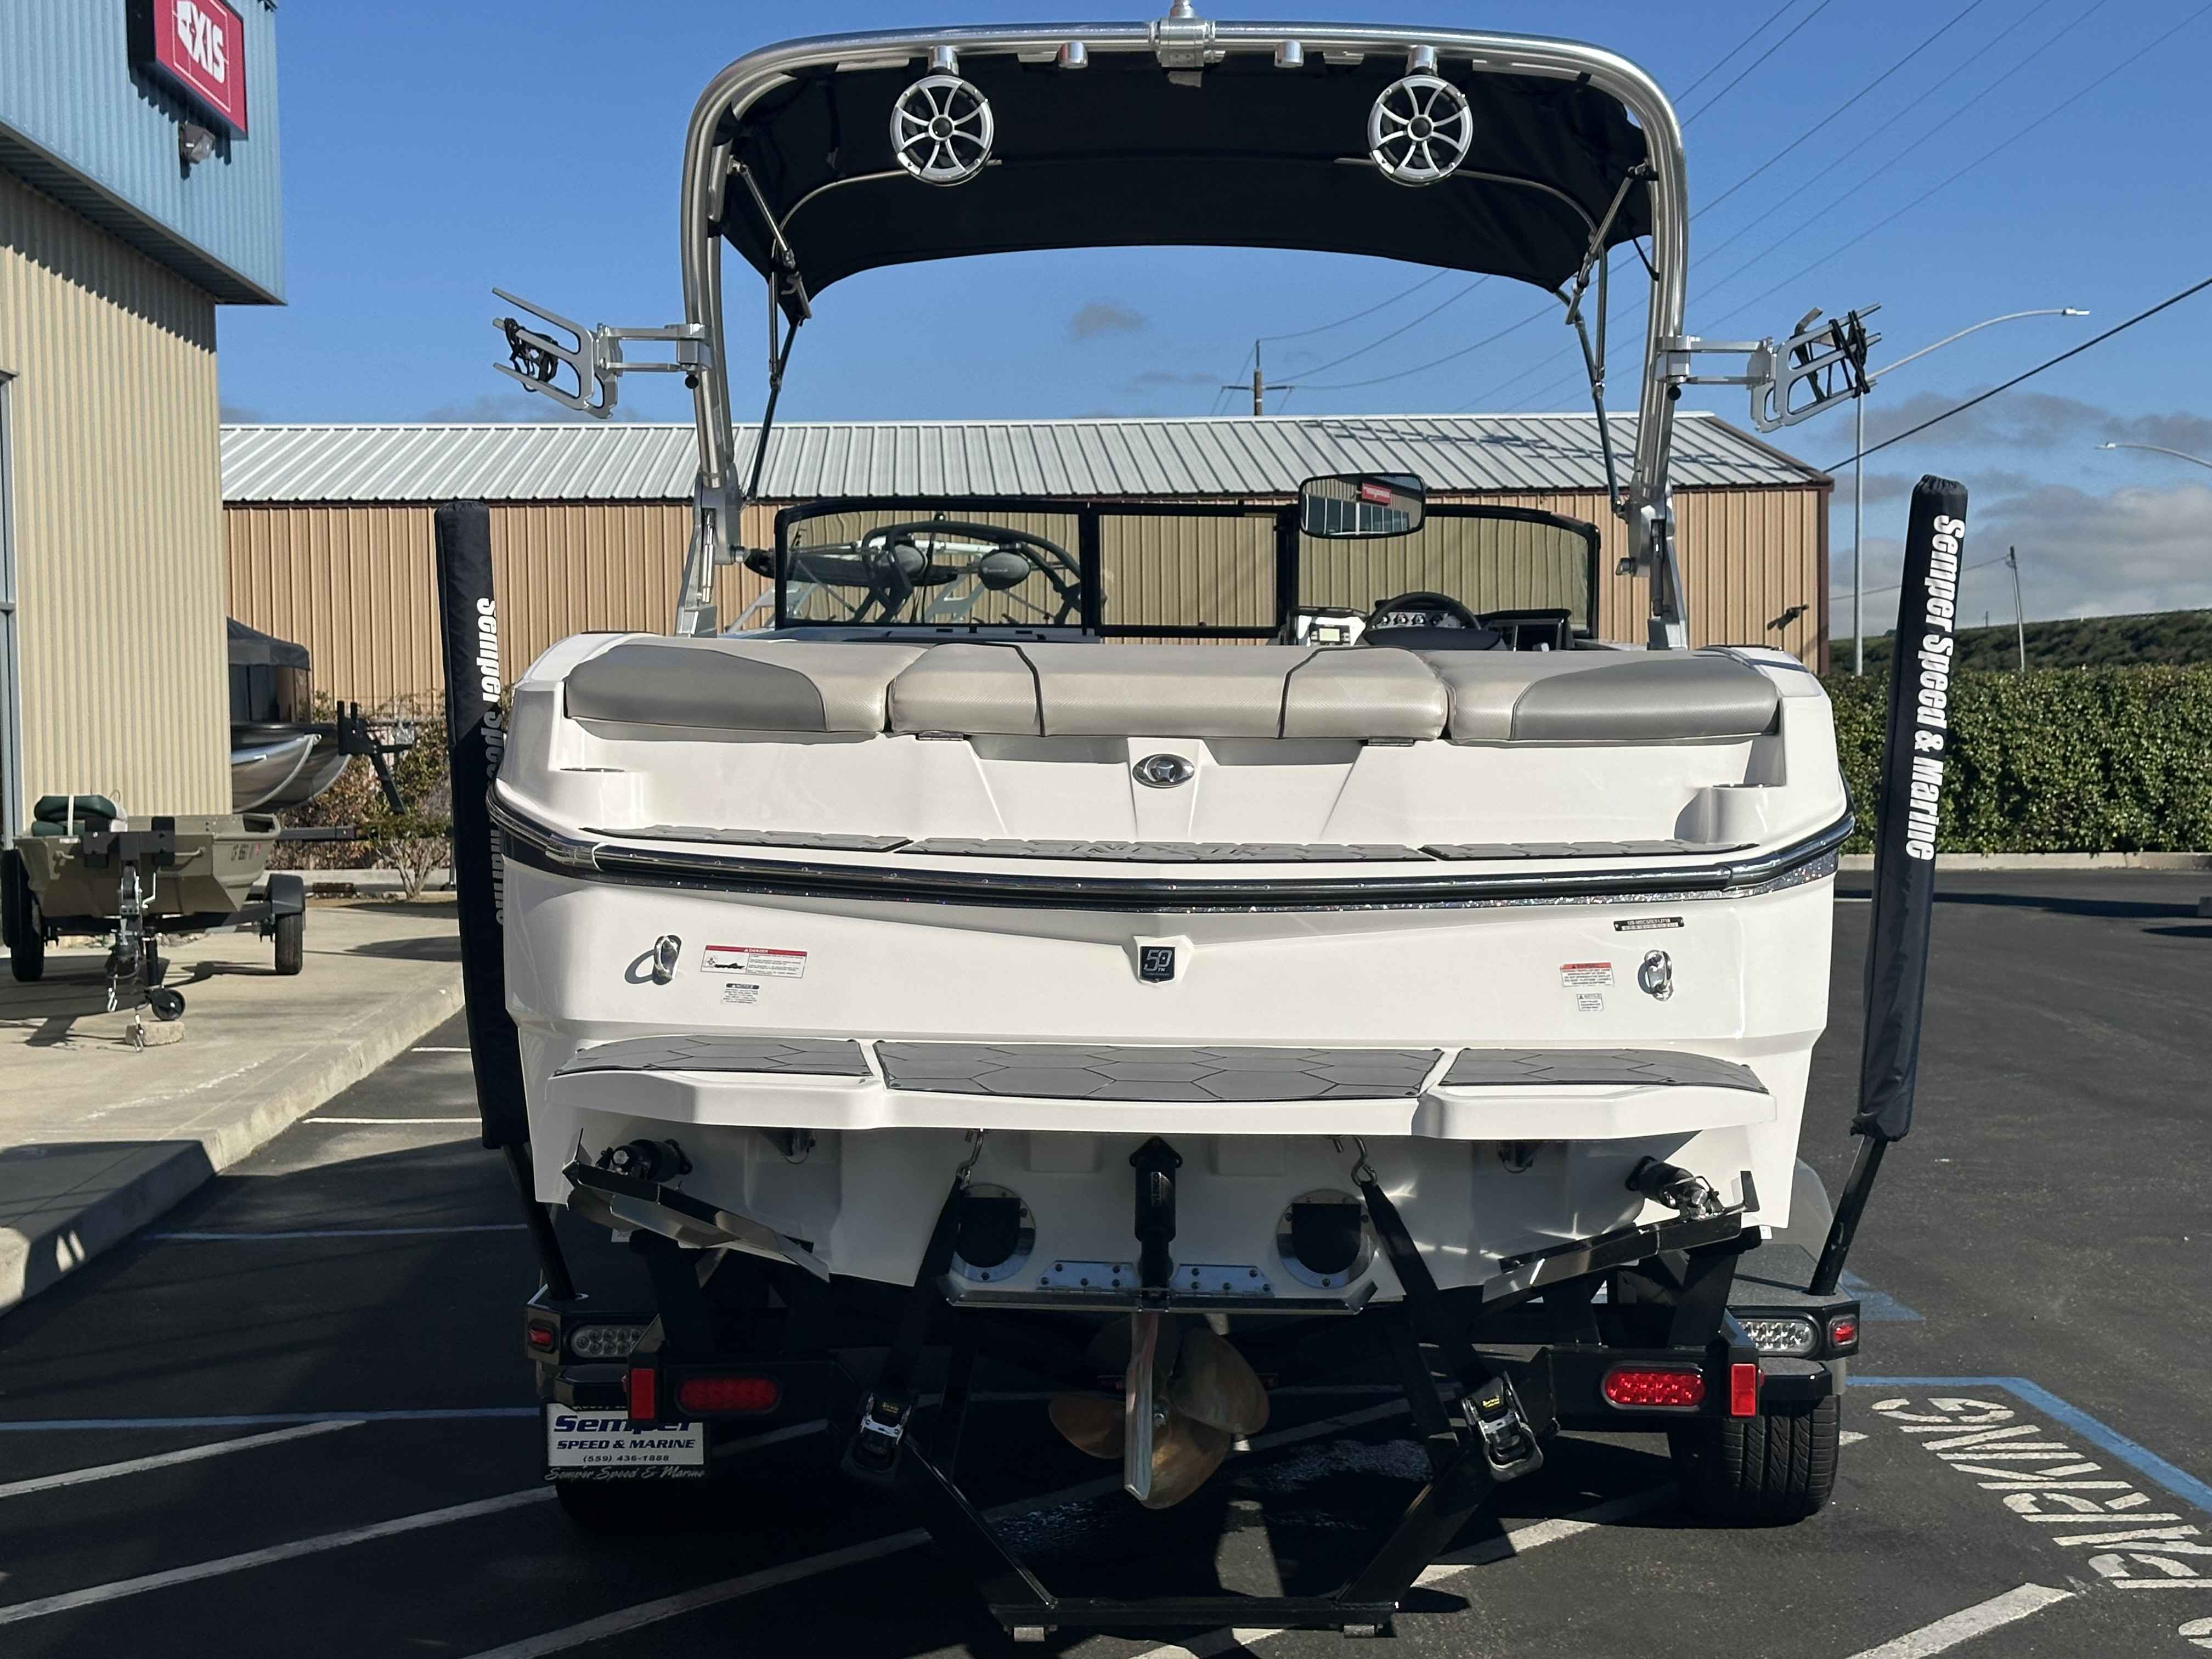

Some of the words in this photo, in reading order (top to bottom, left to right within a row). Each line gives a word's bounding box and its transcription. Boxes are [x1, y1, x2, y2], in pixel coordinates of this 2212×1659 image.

[1924, 514, 1965, 633] Semper
[1917, 634, 1953, 729] Speed
[1913, 730, 1944, 752] &
[1905, 756, 1943, 860] Marine
[557, 1440, 610, 1449] SPEED
[612, 1440, 625, 1449] &
[629, 1439, 696, 1449] MARINE
[583, 1454, 612, 1463] (559)
